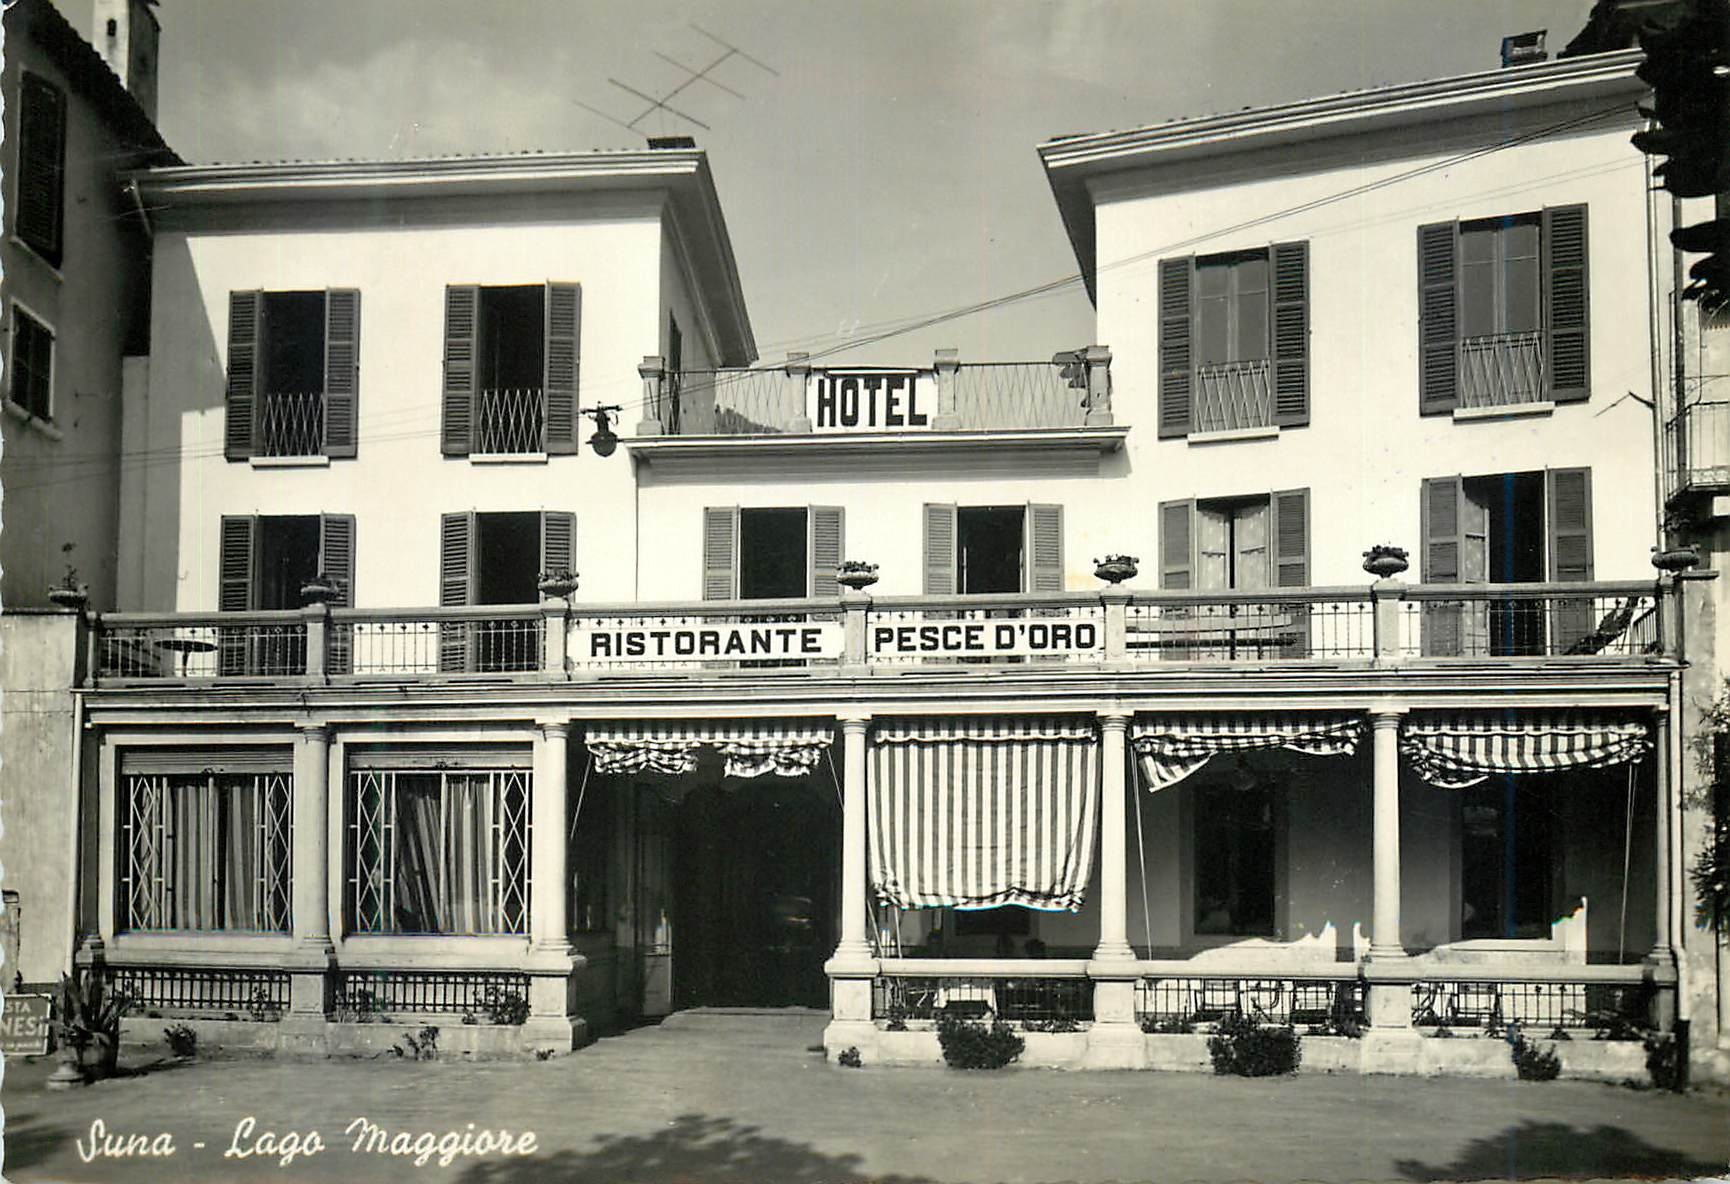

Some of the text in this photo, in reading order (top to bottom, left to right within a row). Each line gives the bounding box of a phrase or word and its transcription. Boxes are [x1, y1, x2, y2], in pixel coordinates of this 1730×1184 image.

[817, 377, 927, 427] HOTEL
[591, 629, 822, 657] RISTORANTE
[875, 624, 1096, 653] PESCE D'ORO
